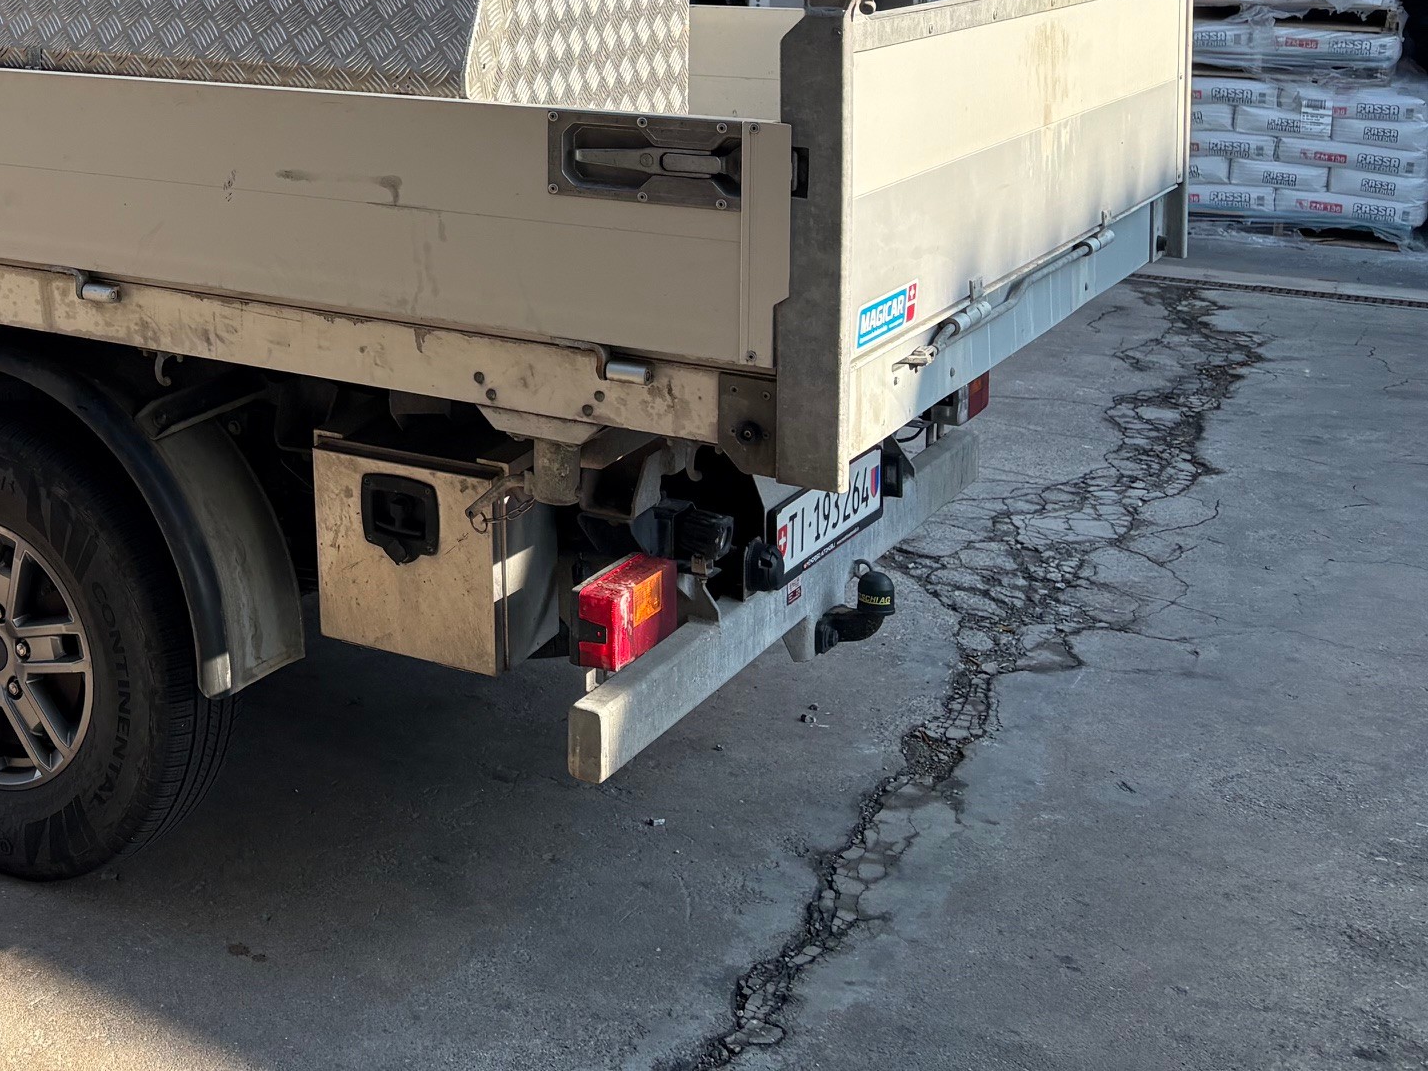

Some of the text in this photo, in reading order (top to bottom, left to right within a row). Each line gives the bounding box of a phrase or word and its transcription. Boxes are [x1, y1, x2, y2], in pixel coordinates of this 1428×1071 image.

[1193, 31, 1227, 41] ASSA
[1356, 103, 1400, 115] FASSA
[1363, 127, 1399, 138] FASSA
[1357, 153, 1401, 167] FASSA
[1361, 178, 1396, 190] FASSA
[1353, 203, 1396, 216] FASSA
[860, 295, 905, 335] MAGICAR
